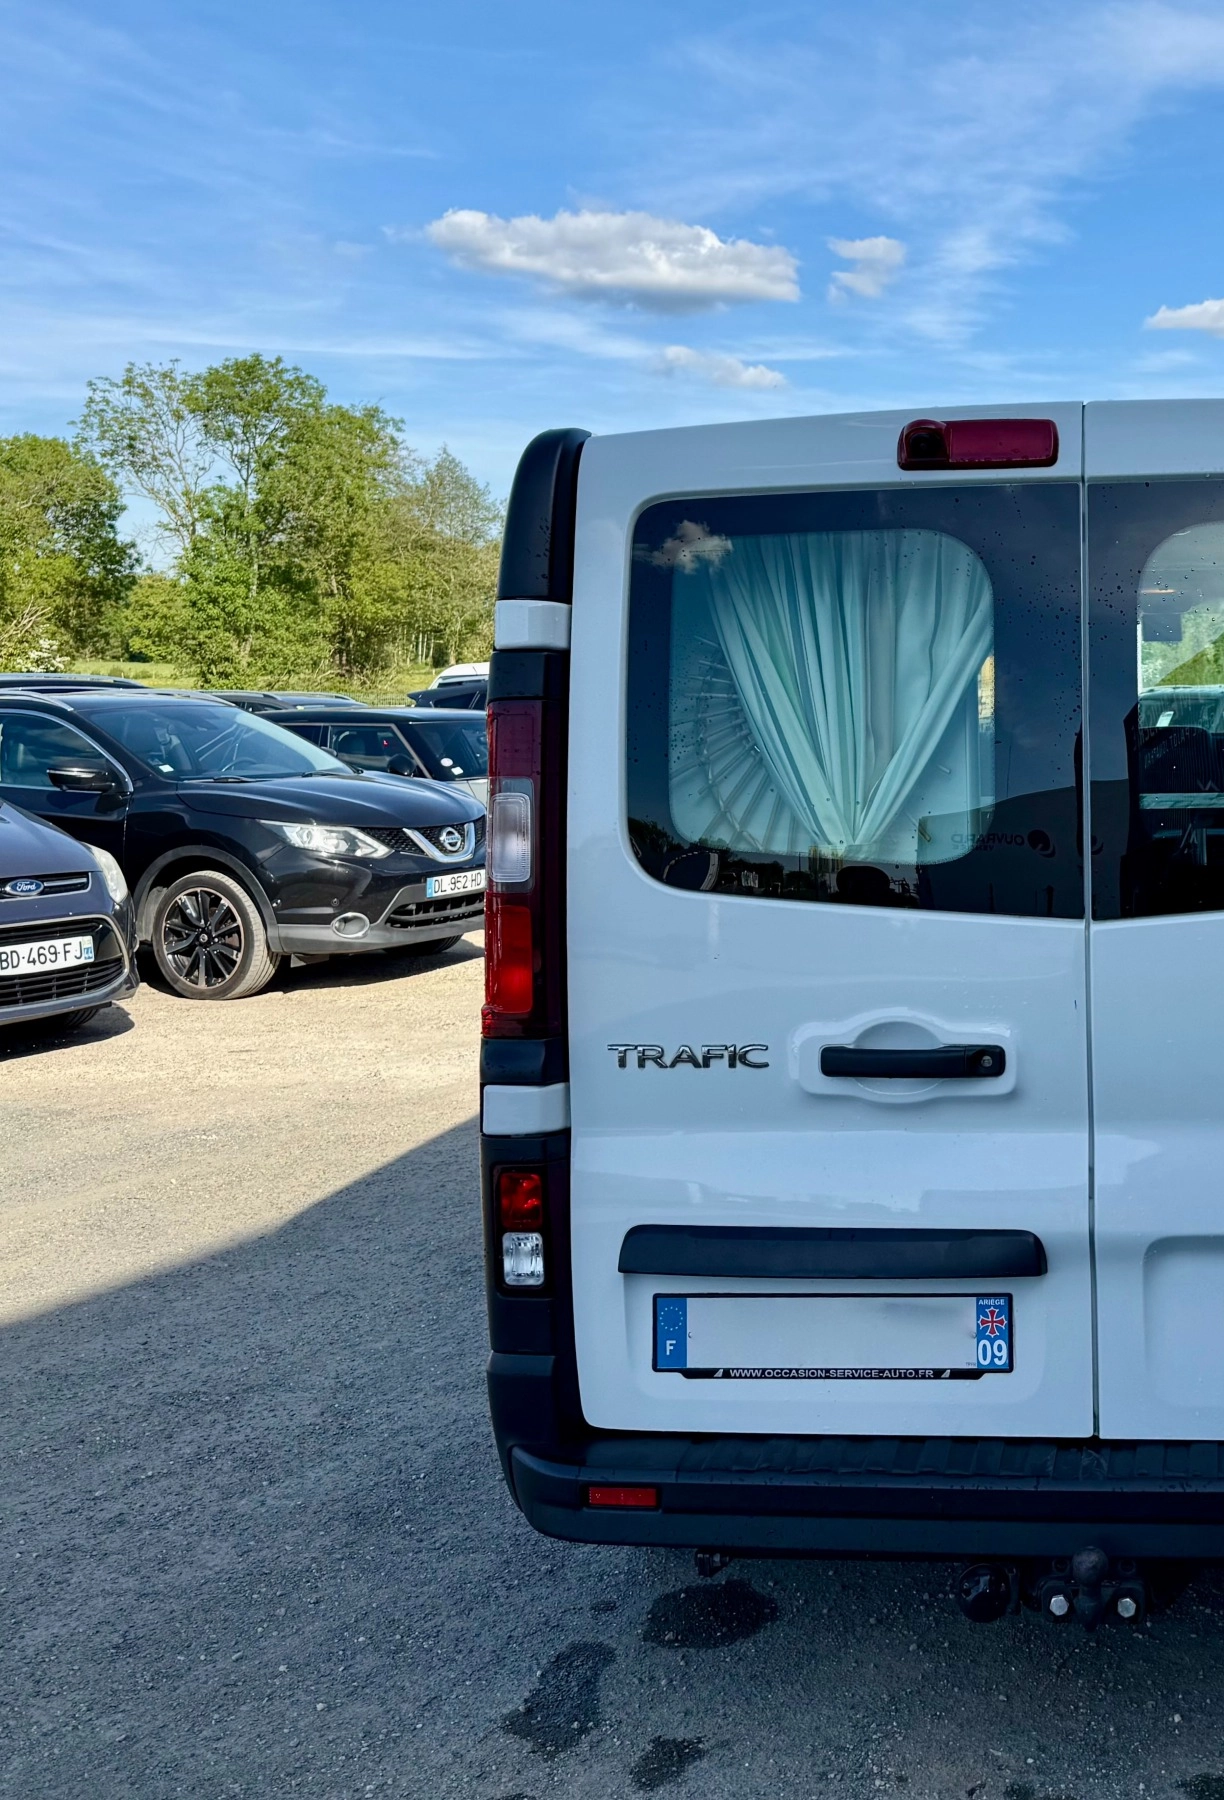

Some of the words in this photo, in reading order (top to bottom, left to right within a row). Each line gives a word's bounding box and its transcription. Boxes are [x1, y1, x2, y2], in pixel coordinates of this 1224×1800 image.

[16, 881, 37, 892] Ford
[607, 1044, 770, 1069] TRAFIC
[666, 1340, 676, 1355] F
[978, 1340, 1007, 1366] 09
[729, 1368, 934, 1379] WWW.OCCASION-SERVICE-AUTO.FR
